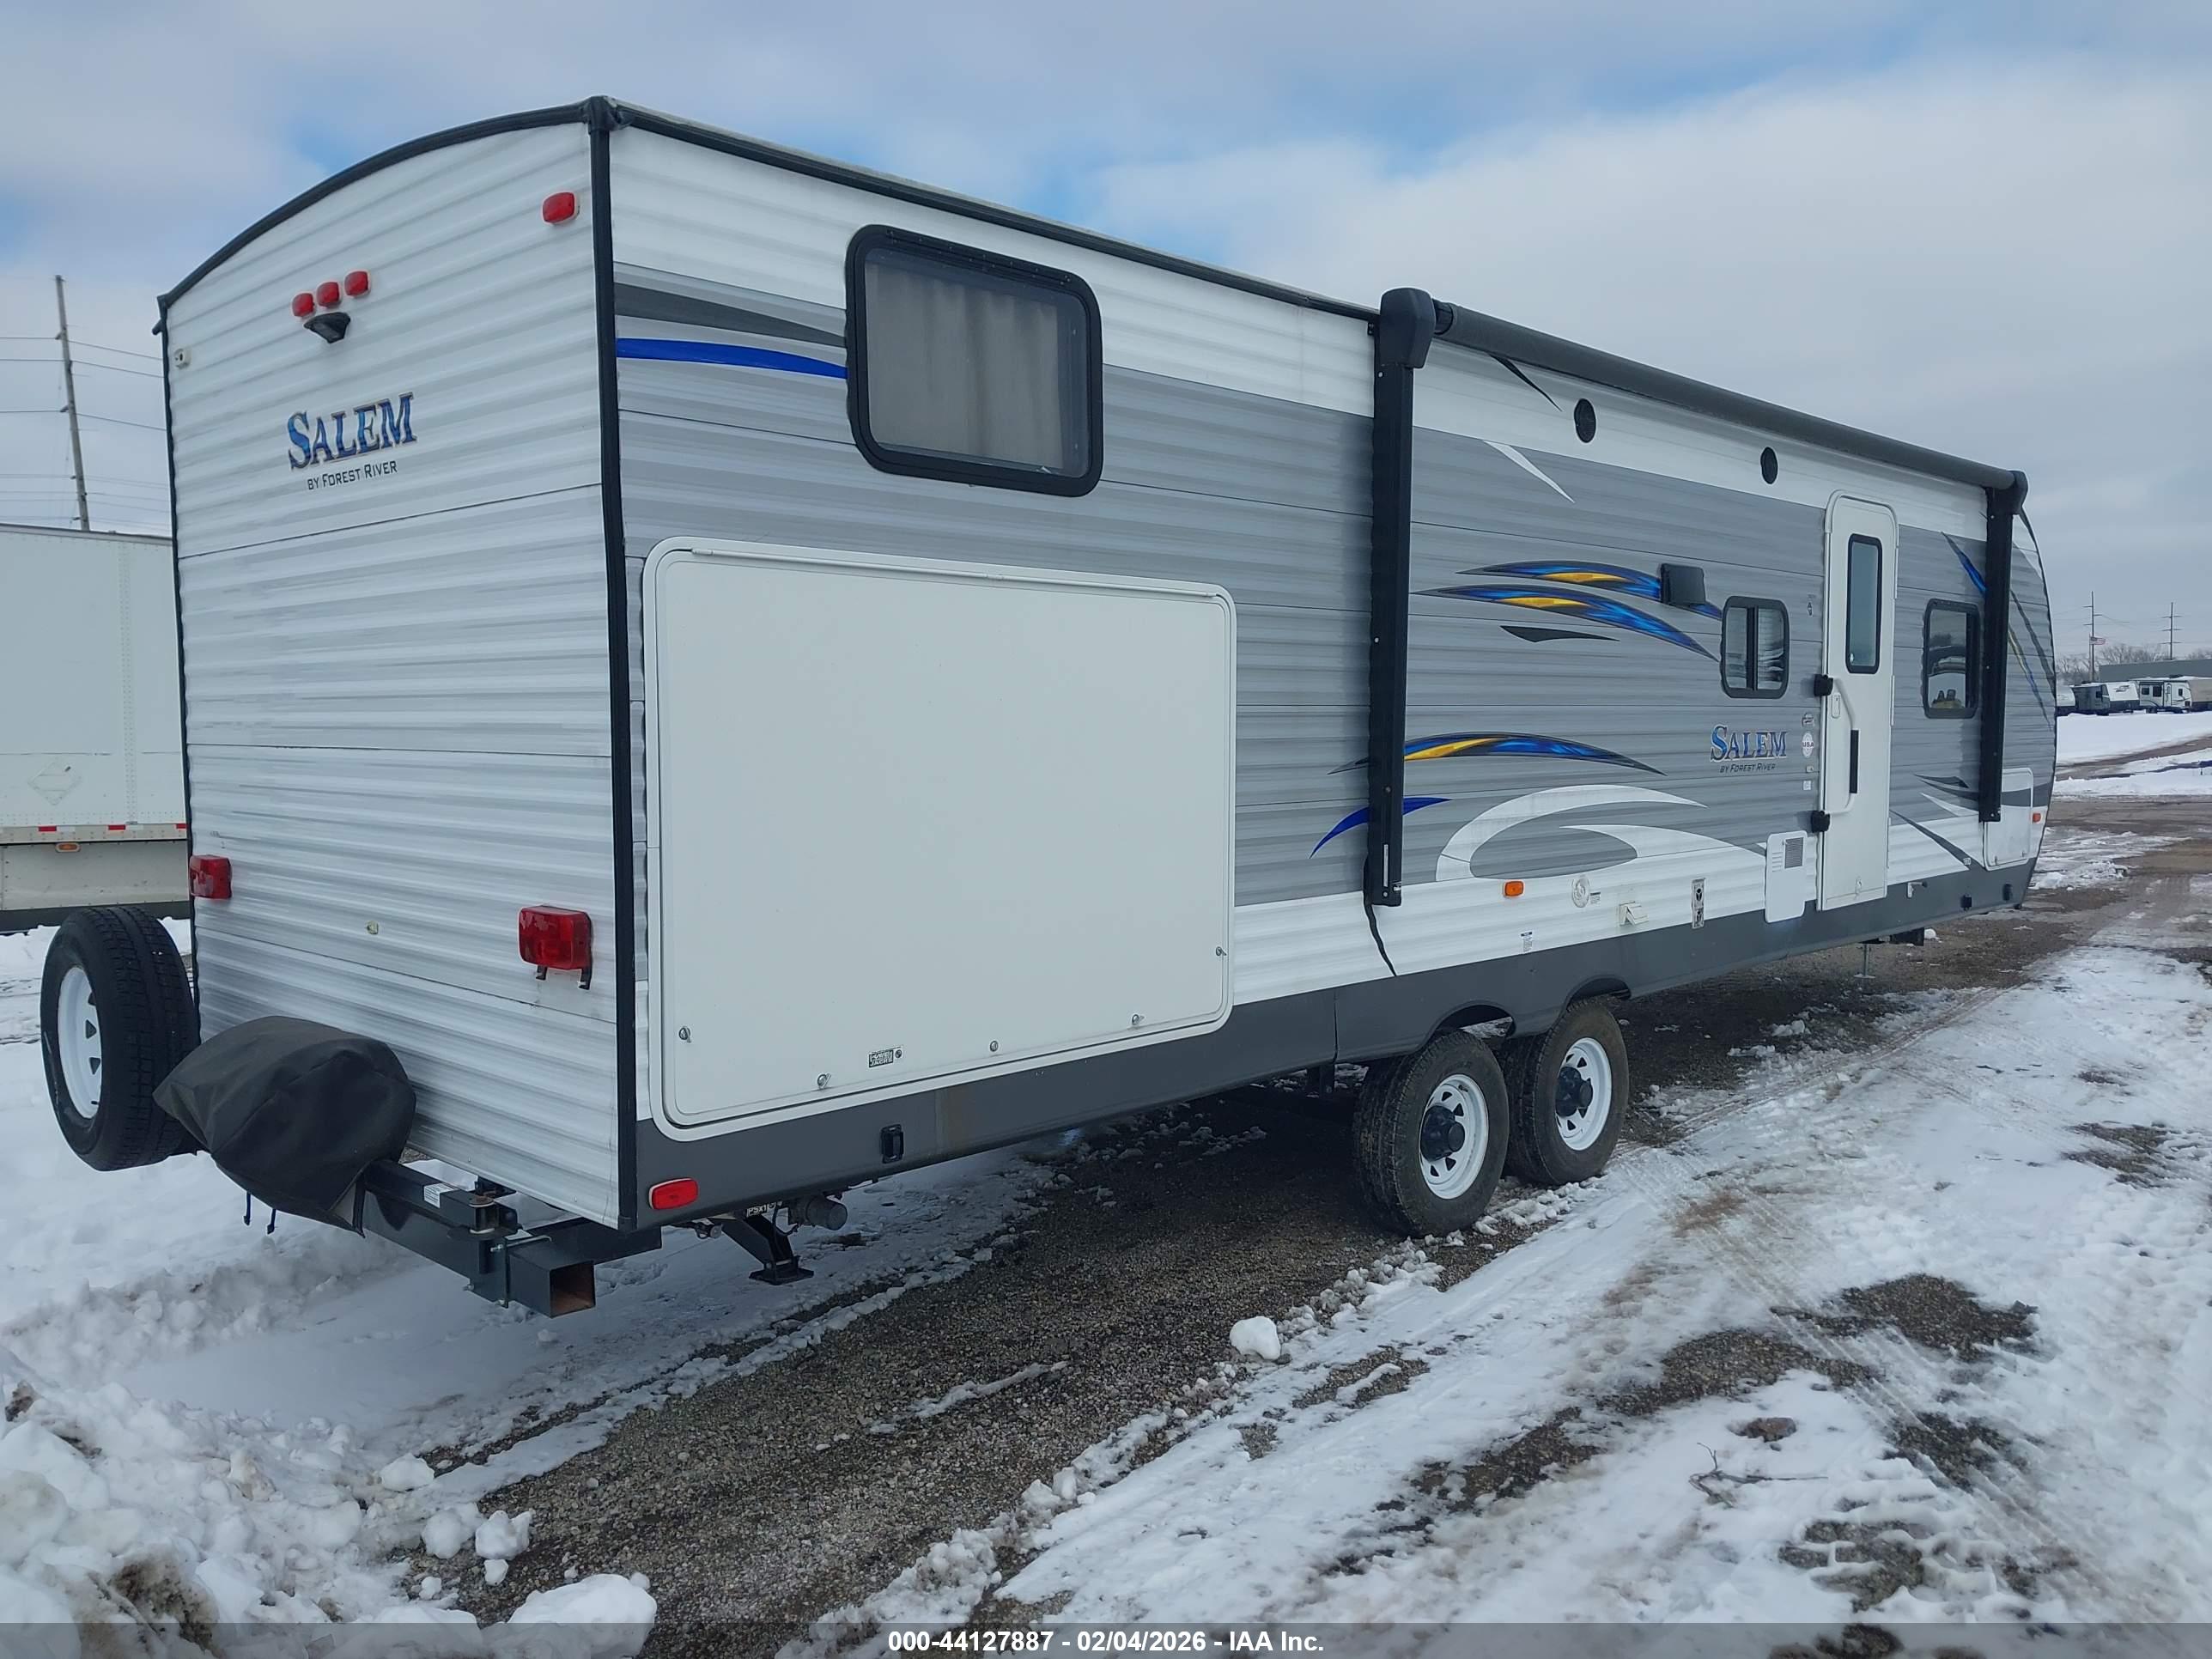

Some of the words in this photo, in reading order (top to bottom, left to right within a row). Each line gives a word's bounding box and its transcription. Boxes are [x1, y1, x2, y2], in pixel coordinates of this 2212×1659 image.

[288, 392, 417, 470] SALEM
[307, 477, 319, 490] BY
[322, 468, 362, 488] FOREST
[365, 460, 398, 479] RIVER
[1710, 724, 1787, 761] SALEM
[1720, 764, 1729, 773] BY
[1730, 763, 1755, 772] FOREST
[1756, 763, 1776, 771] RIVER
